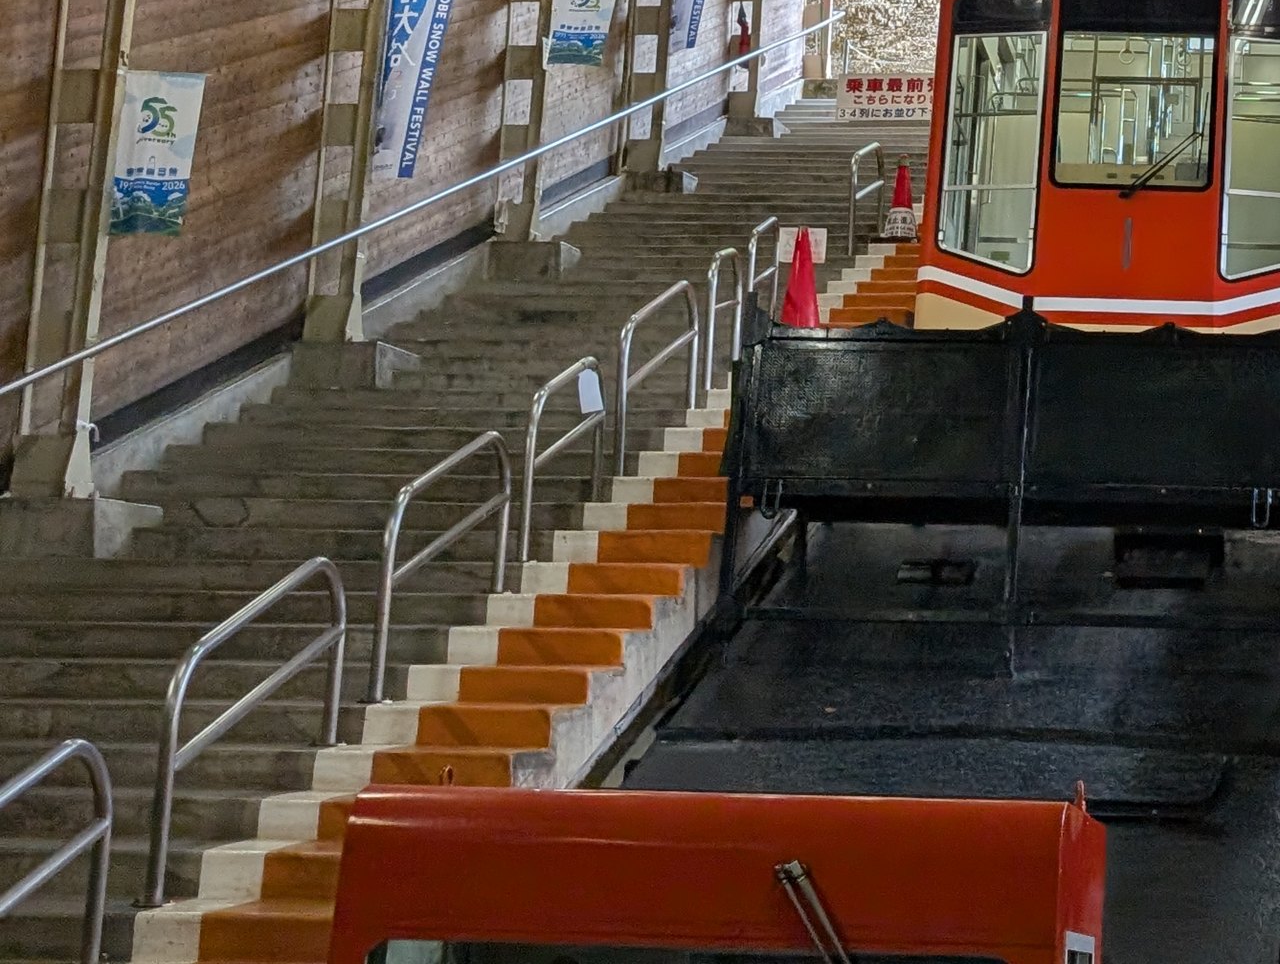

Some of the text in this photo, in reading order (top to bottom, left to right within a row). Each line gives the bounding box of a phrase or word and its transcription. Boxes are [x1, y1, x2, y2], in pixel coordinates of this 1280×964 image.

[689, 0, 703, 41] FESTIVAL
[426, 22, 444, 63] SNOW
[416, 67, 434, 103] WALL
[853, 94, 933, 105] こちらになり
[402, 107, 424, 168] FESTIVAL
[162, 181, 186, 191] 2026
